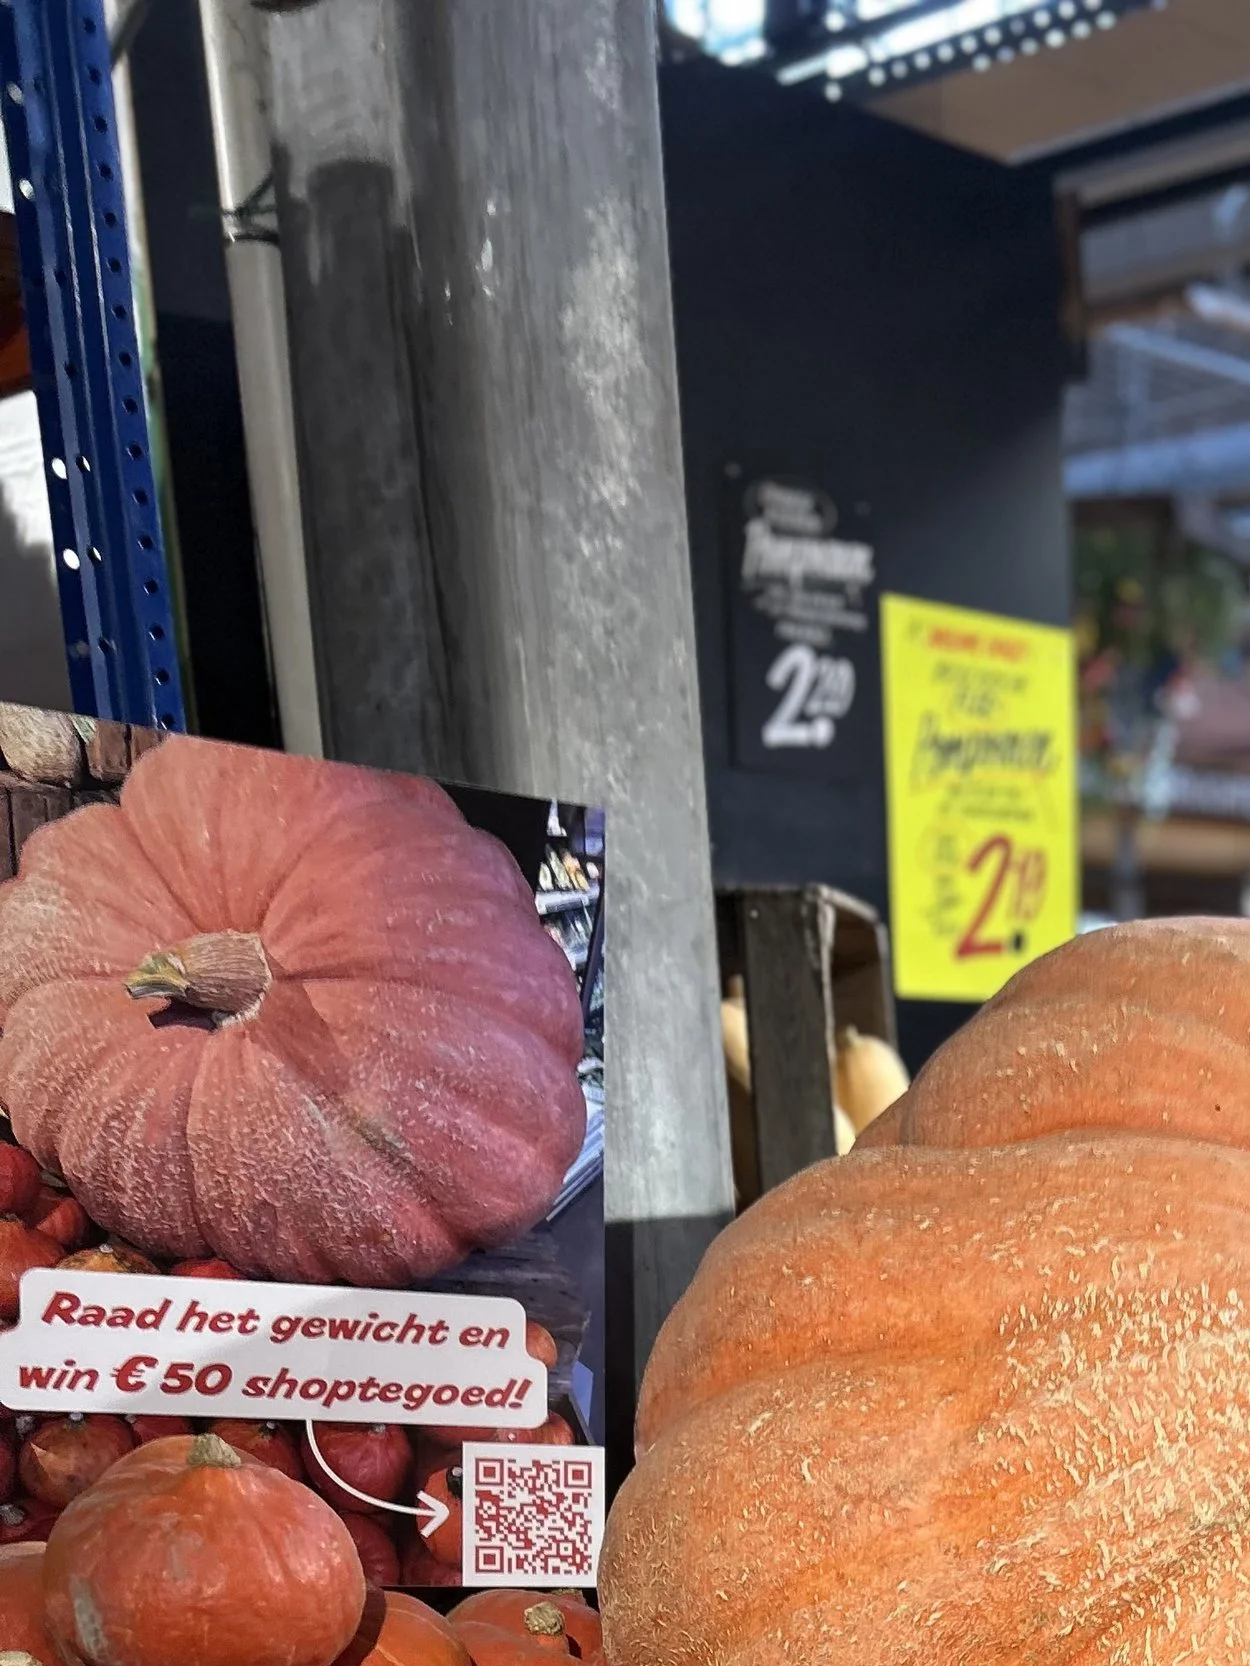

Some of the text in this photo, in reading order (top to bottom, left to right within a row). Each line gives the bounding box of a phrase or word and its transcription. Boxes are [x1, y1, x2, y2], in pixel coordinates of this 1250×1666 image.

[42, 1291, 511, 1348] Raad het gewicht en
[18, 1359, 99, 1391] win
[241, 1368, 532, 1411] shoptegoed!
